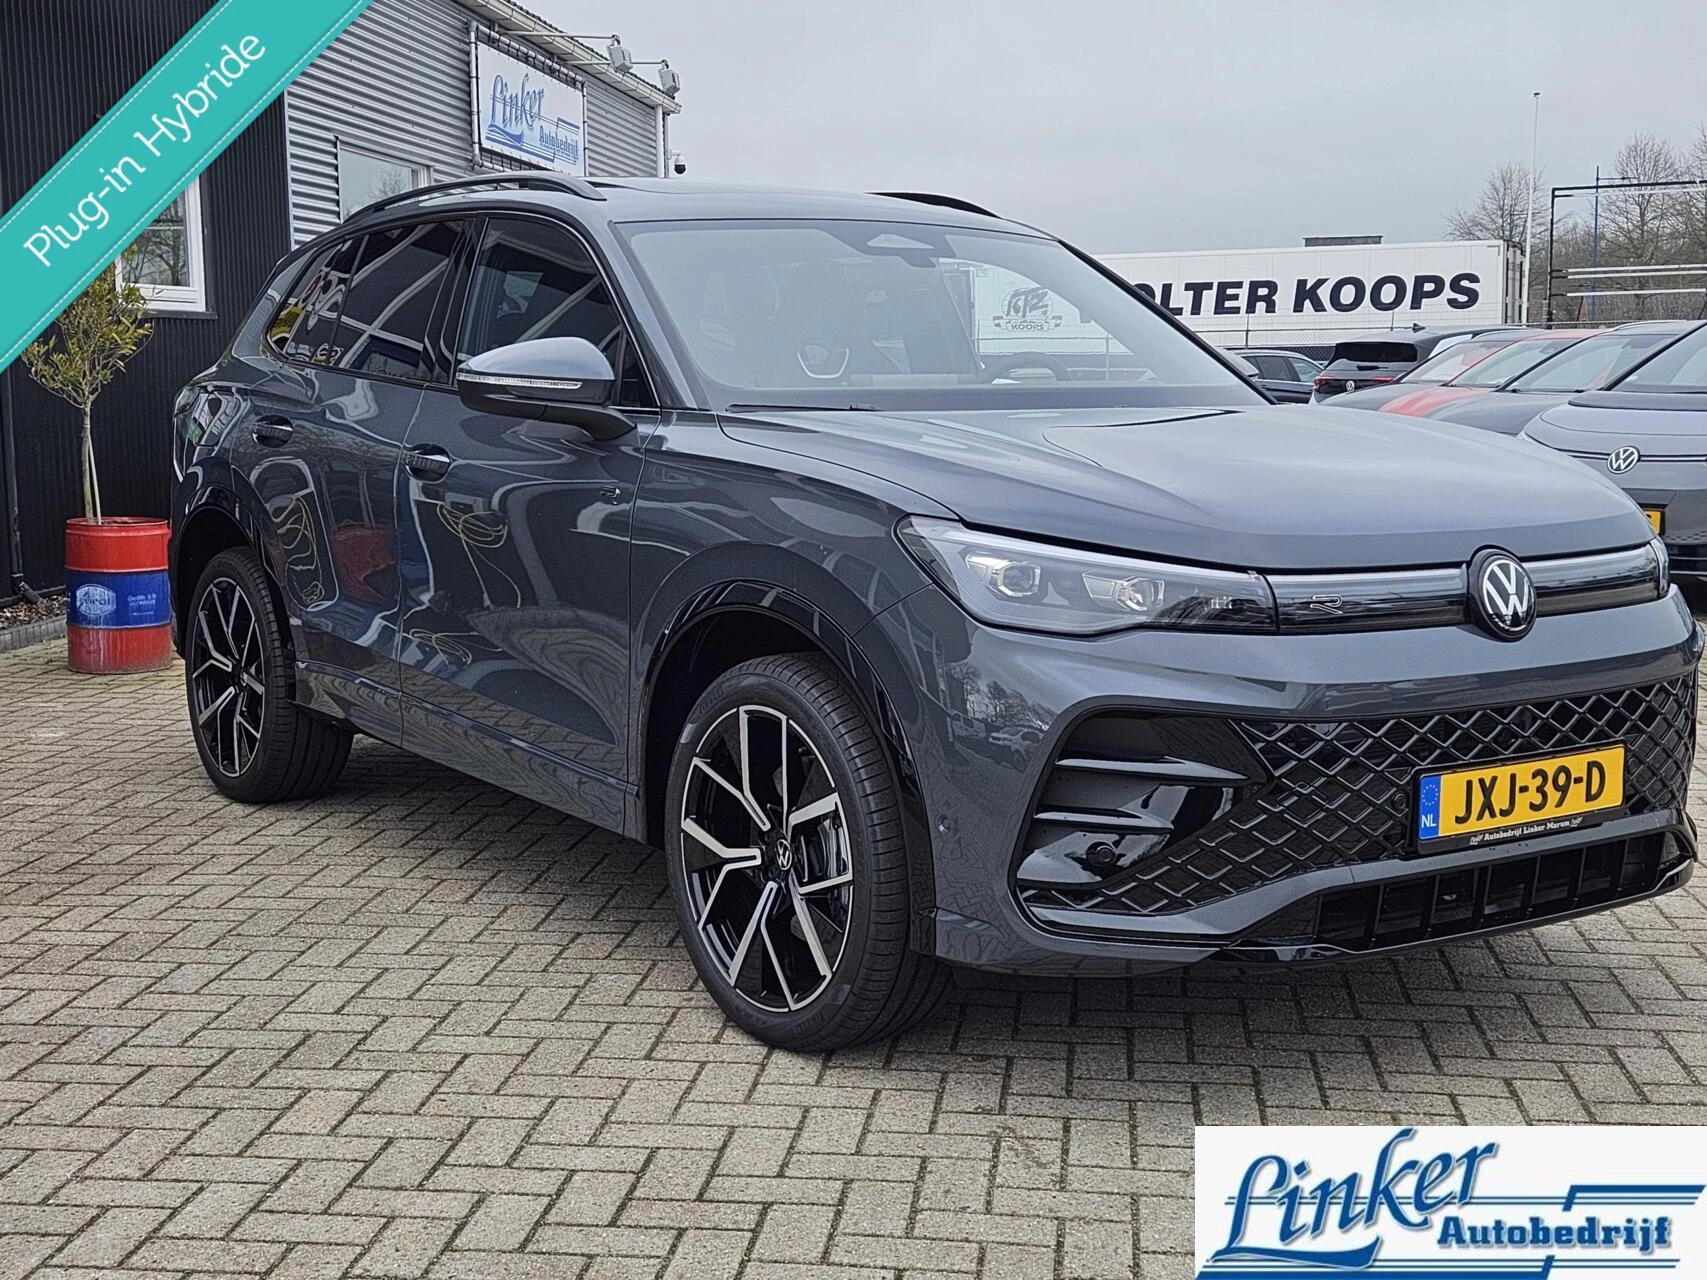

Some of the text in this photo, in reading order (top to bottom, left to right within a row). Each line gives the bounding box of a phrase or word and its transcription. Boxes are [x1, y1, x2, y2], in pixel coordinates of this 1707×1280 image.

[489, 72, 545, 140] Linker
[539, 126, 580, 160] Autobedrijf
[1293, 273, 1481, 313] KOOPS
[1011, 322, 1045, 331] KOOPS
[1309, 594, 1344, 614] R
[1454, 760, 1606, 825] JXJ-39-D
[1421, 814, 1437, 828] NL
[1484, 827, 1522, 841] Autobedrijf
[1523, 823, 1545, 834] Linker
[1546, 820, 1570, 830] Marum
